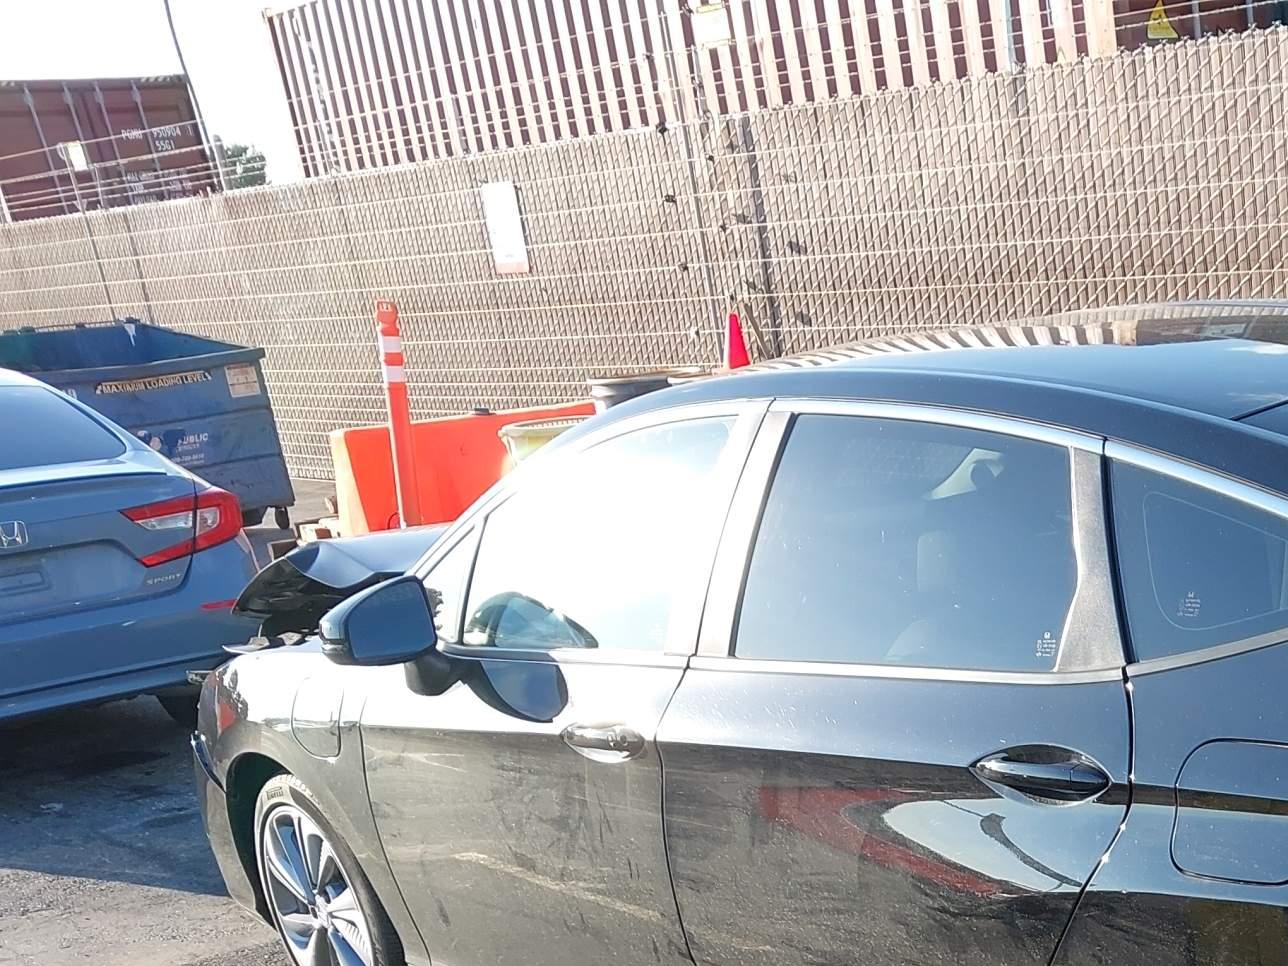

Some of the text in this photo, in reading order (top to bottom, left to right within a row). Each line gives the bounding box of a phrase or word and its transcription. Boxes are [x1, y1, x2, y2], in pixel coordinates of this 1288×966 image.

[102, 373, 206, 394] MAXIMUM LOADING LEVEL
[147, 573, 182, 585] SPORT
